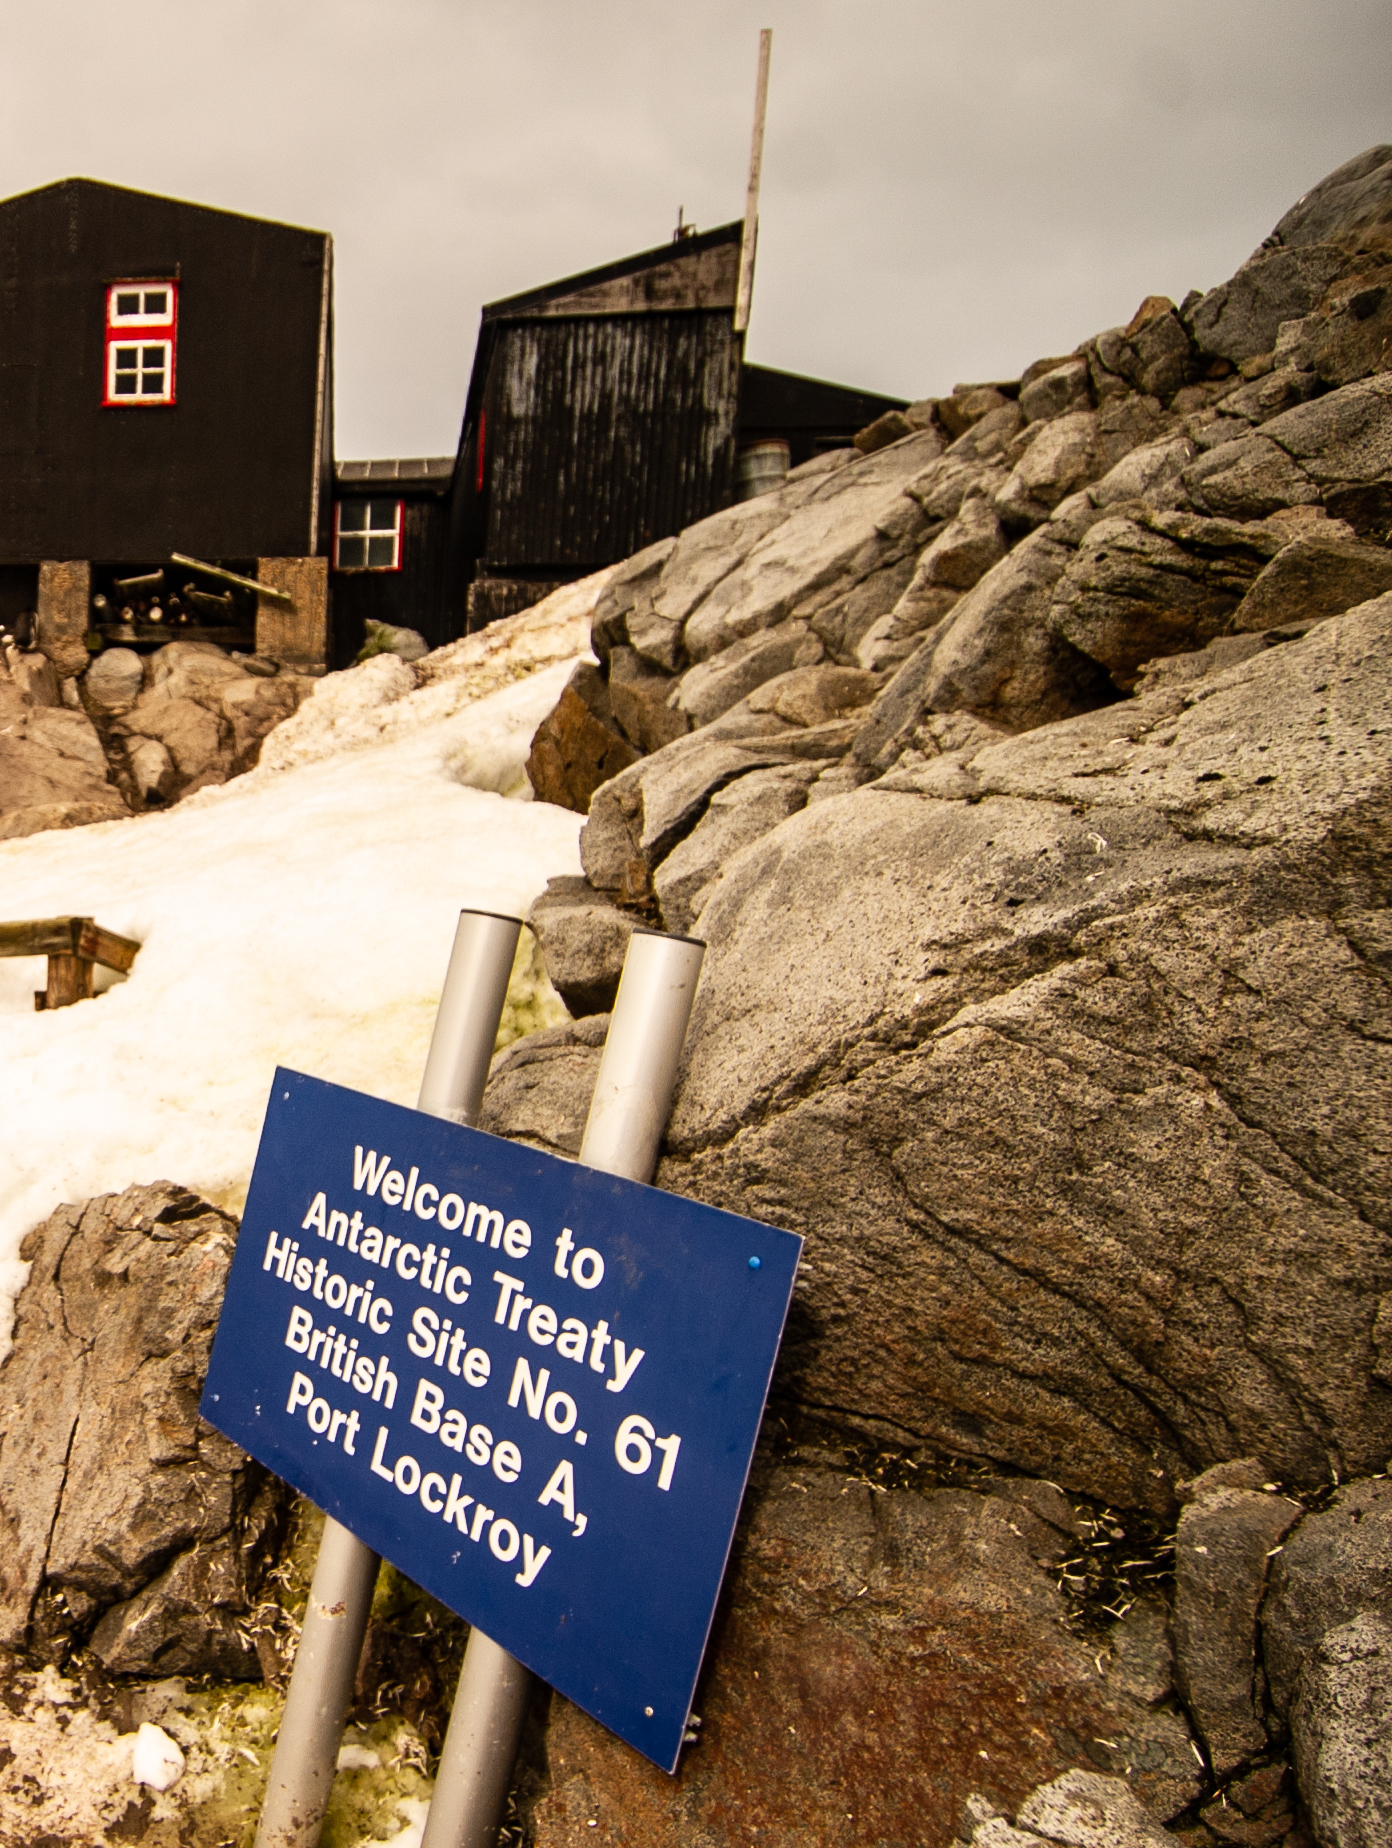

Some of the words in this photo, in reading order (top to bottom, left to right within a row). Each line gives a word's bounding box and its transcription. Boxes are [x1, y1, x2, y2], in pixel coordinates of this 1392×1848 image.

[301, 1191, 472, 1305] Antarctic
[492, 1270, 646, 1393] Treaty
[352, 1144, 532, 1259] Welcome
[553, 1227, 605, 1290] to
[262, 1230, 394, 1335] Historic
[406, 1306, 491, 1388] Site
[507, 1356, 588, 1446] No.
[614, 1414, 682, 1492] 61
[284, 1304, 399, 1410] British
[409, 1377, 522, 1483] Base
[537, 1459, 588, 1537] A,
[286, 1370, 361, 1456] Port
[370, 1425, 552, 1588] Lockroy
